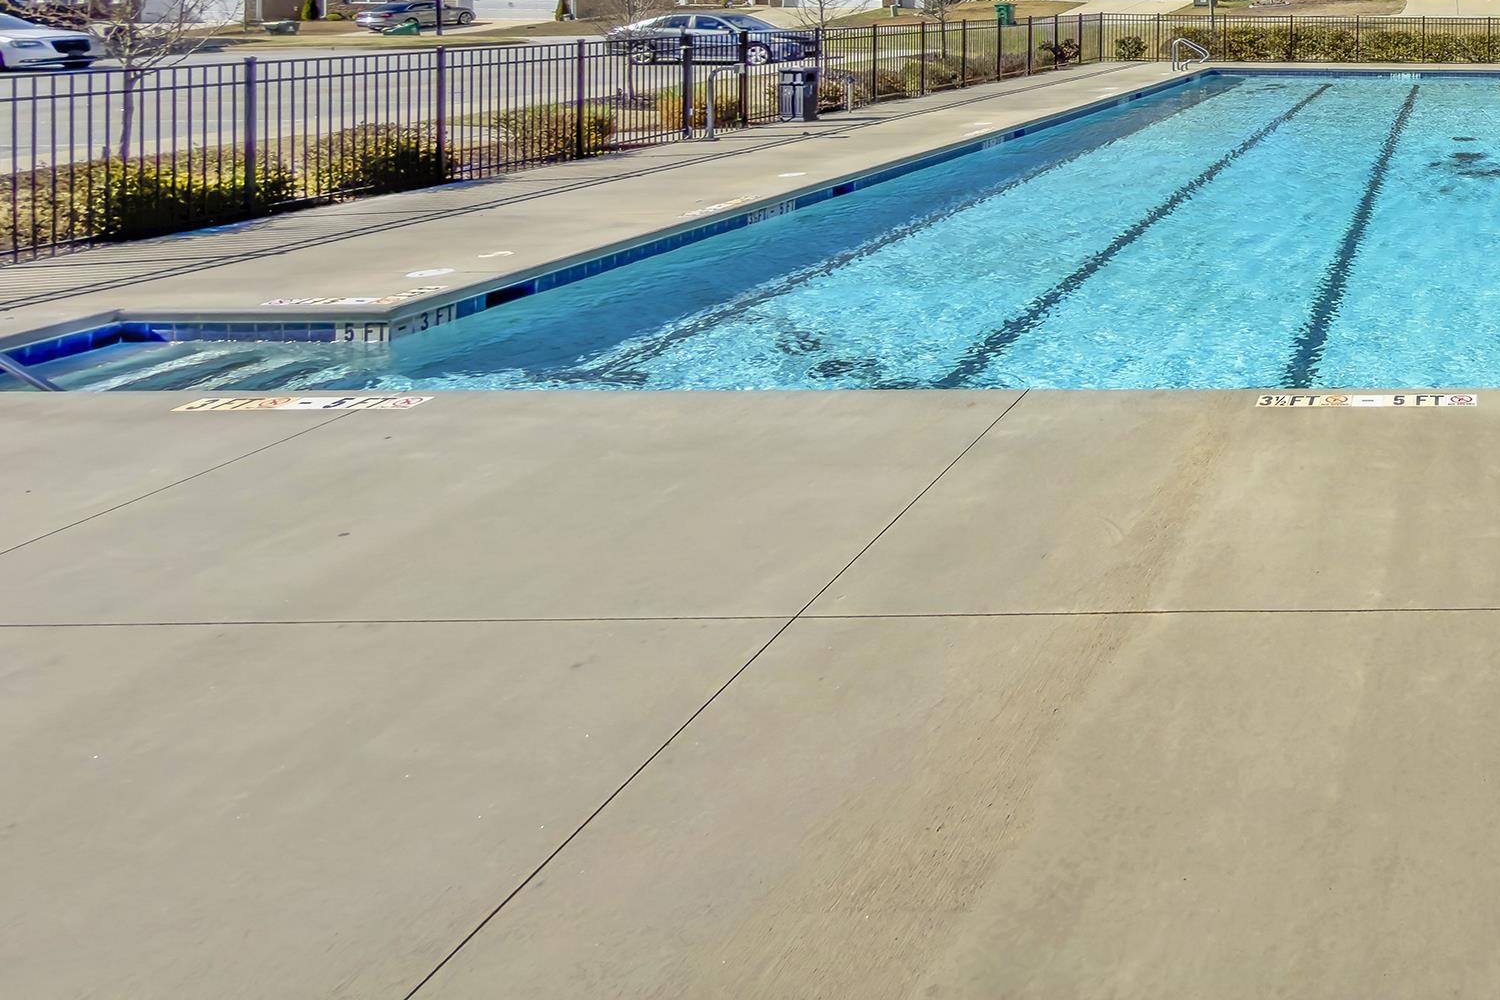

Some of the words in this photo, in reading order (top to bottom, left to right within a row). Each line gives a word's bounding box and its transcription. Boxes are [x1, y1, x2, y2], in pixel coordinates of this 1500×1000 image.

[344, 323, 354, 341] 5
[365, 322, 388, 341] FT
[421, 312, 429, 330] 3
[436, 304, 454, 325] FT
[186, 399, 219, 409] 3
[211, 398, 265, 409] FT
[323, 397, 355, 409] 5
[346, 397, 397, 408] FT
[1393, 395, 1405, 405] 5
[1416, 395, 1444, 405] FT
